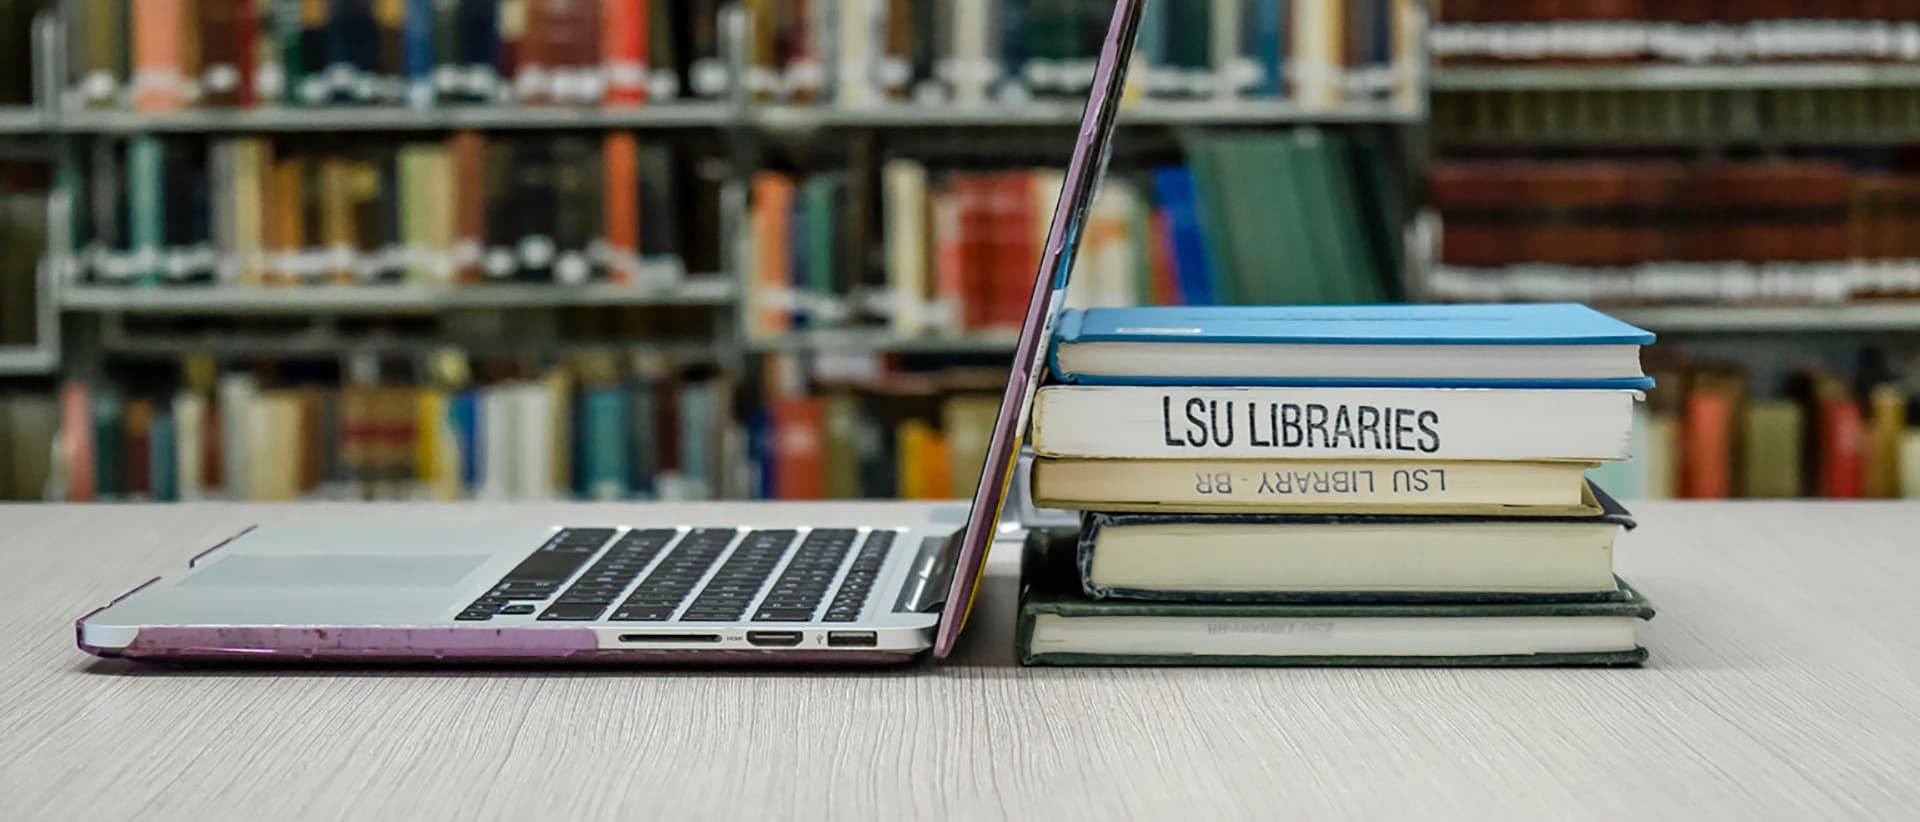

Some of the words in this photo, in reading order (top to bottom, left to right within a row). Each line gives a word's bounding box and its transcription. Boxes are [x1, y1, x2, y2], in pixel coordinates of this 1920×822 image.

[1163, 396, 1234, 447] LSU
[1248, 402, 1440, 453] LIBRARIES
[1195, 470, 1233, 494] BR
[1258, 470, 1375, 494] LIBRARY
[1393, 469, 1446, 493] LSU
